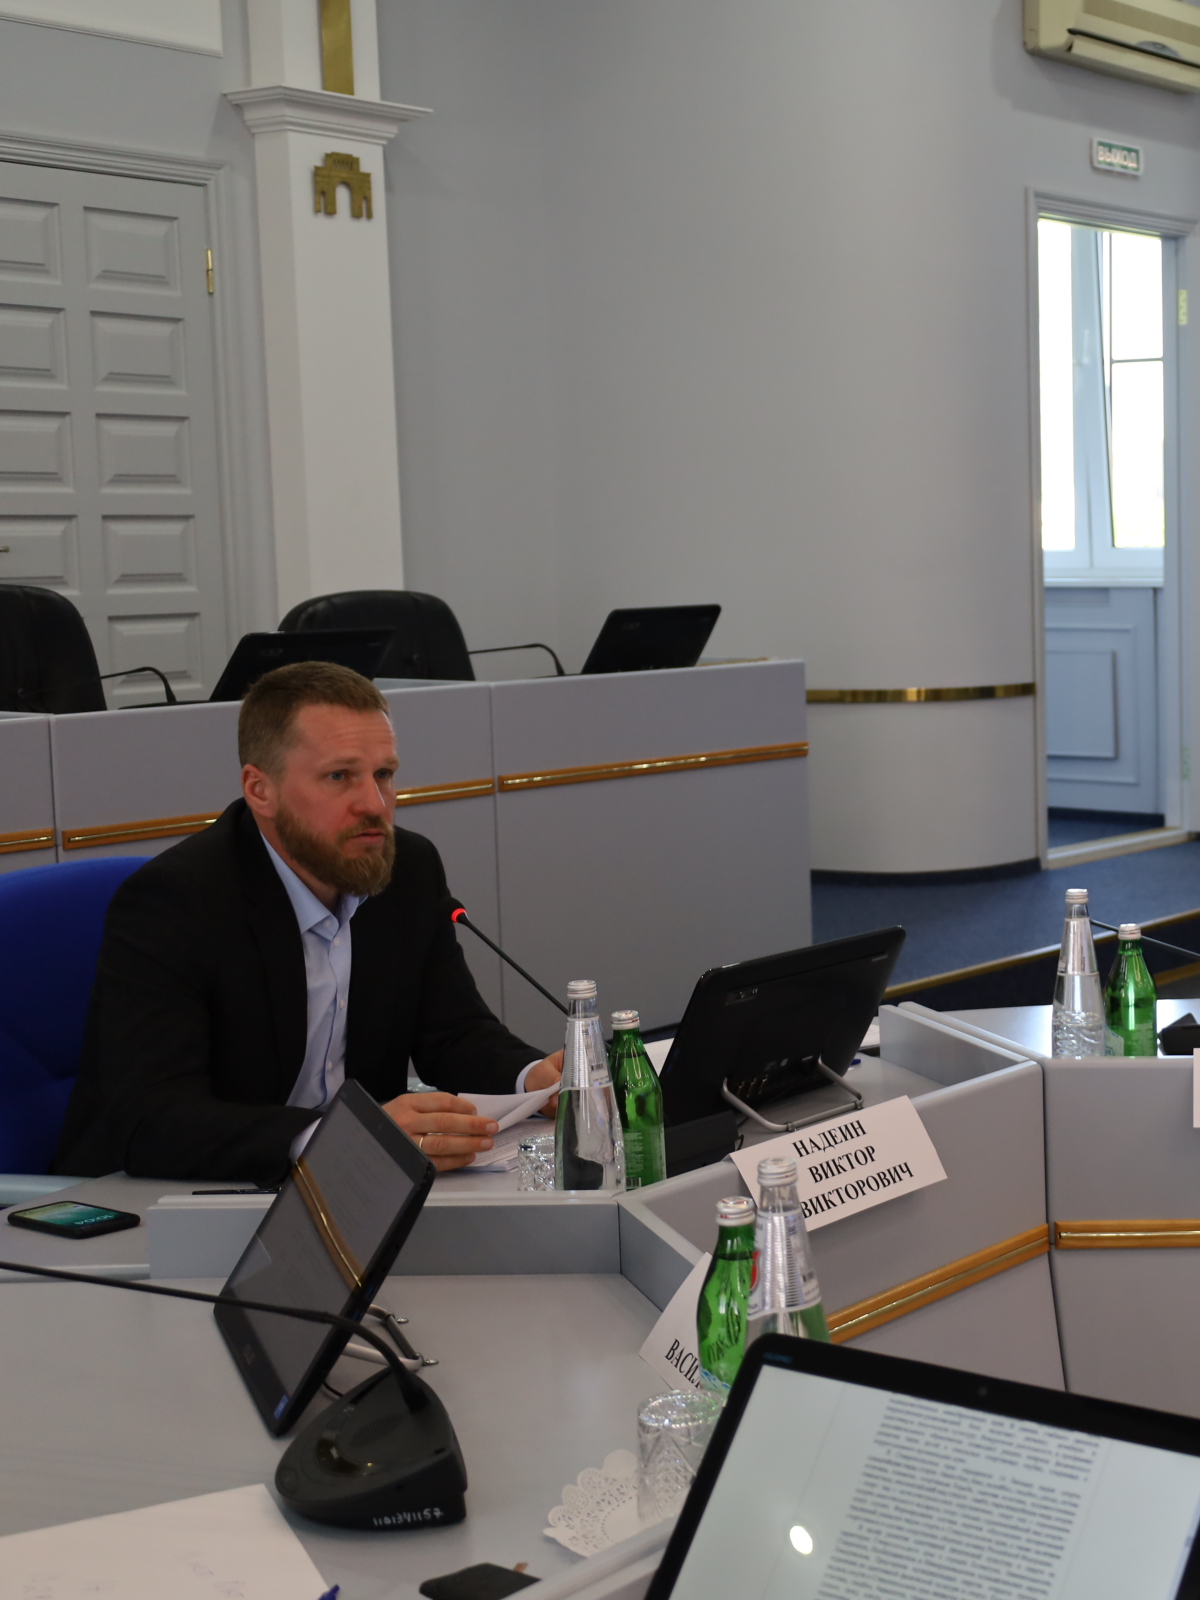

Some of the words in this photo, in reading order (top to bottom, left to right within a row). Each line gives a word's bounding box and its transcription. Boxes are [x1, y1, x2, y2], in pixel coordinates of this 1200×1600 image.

[1098, 144, 1138, 169] ВЫХОД
[792, 1120, 867, 1158] НАДЕИН
[808, 1145, 876, 1183] ВИКТОР
[800, 1162, 914, 1218] ВИКТОРОВИЧ
